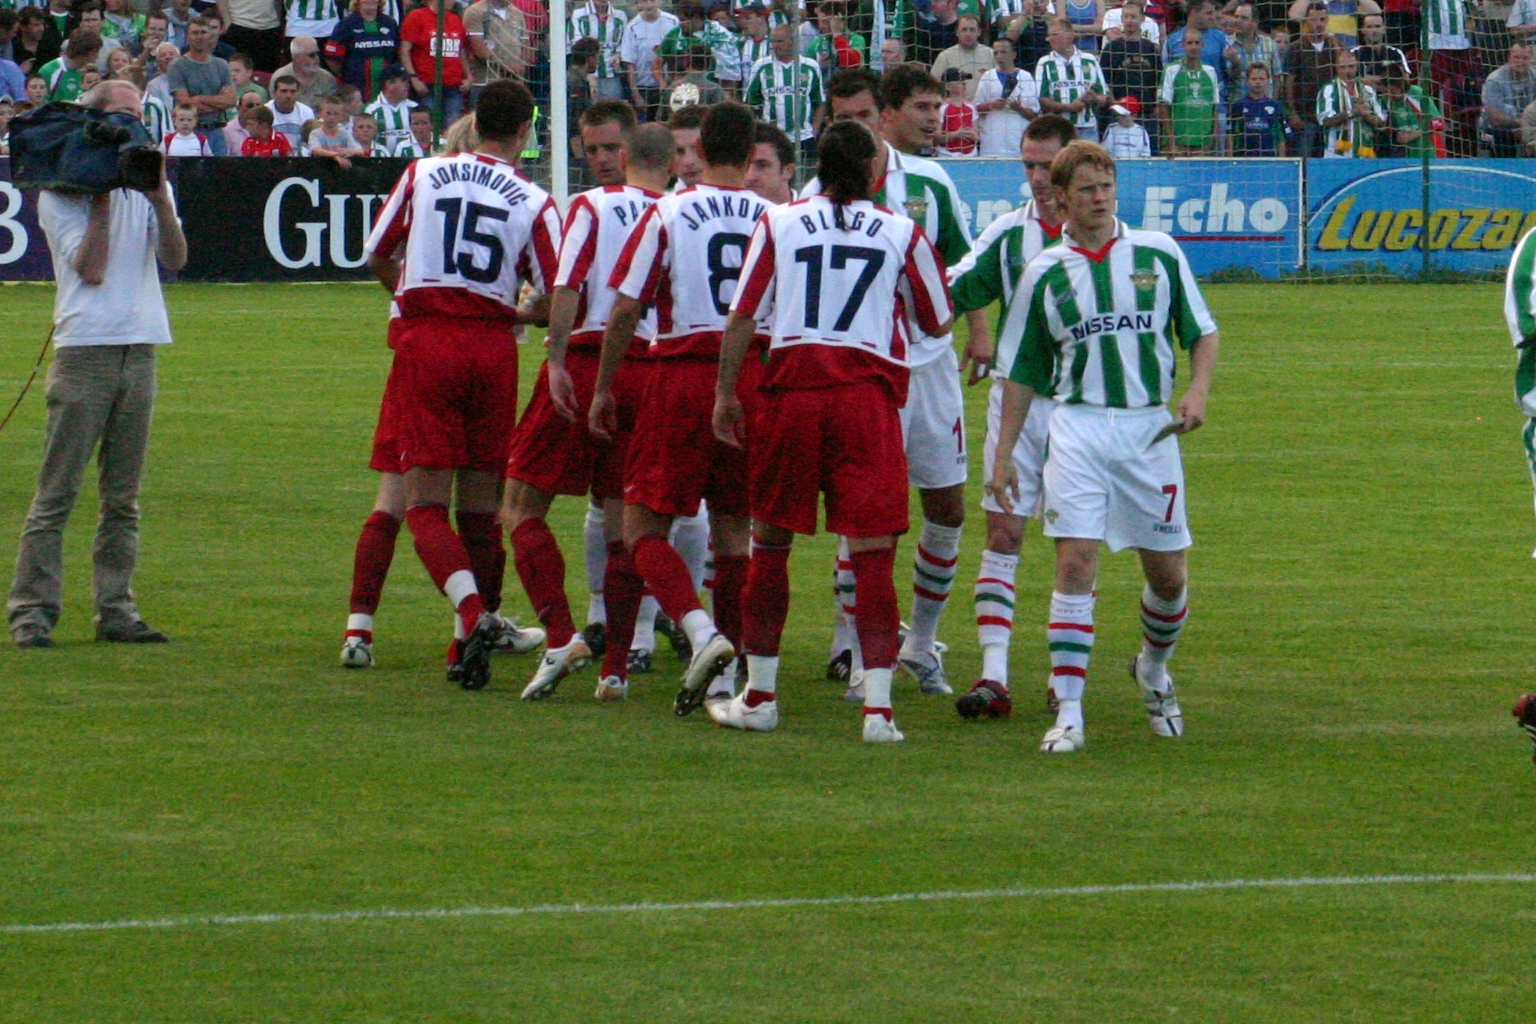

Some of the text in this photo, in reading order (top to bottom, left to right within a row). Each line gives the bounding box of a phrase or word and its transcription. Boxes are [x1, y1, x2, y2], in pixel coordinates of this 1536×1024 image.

[354, 39, 395, 50] NISSAN
[767, 87, 808, 97] NISSN
[680, 195, 765, 231] JANKOV
[1142, 183, 1288, 235] Echo
[434, 197, 510, 284] 15
[707, 231, 753, 316] 8
[794, 244, 886, 332] 17
[1071, 314, 1153, 342] NISSAN
[1162, 484, 1177, 522] 7
